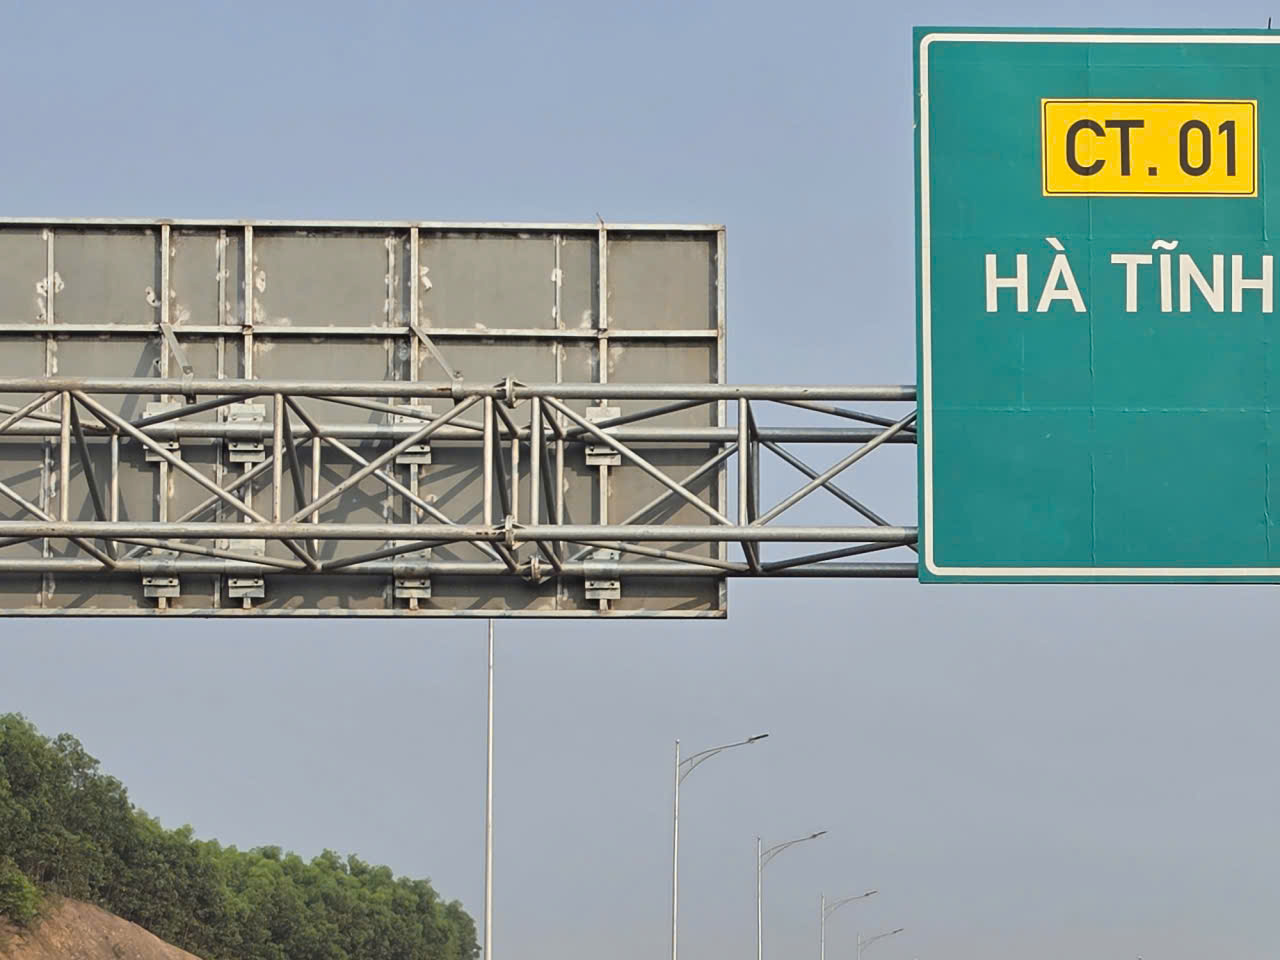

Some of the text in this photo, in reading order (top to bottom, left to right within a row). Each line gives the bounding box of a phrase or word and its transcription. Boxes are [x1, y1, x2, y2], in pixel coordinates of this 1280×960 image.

[1179, 120, 1237, 177] 01
[985, 237, 1274, 313] HÀ TĨNH
